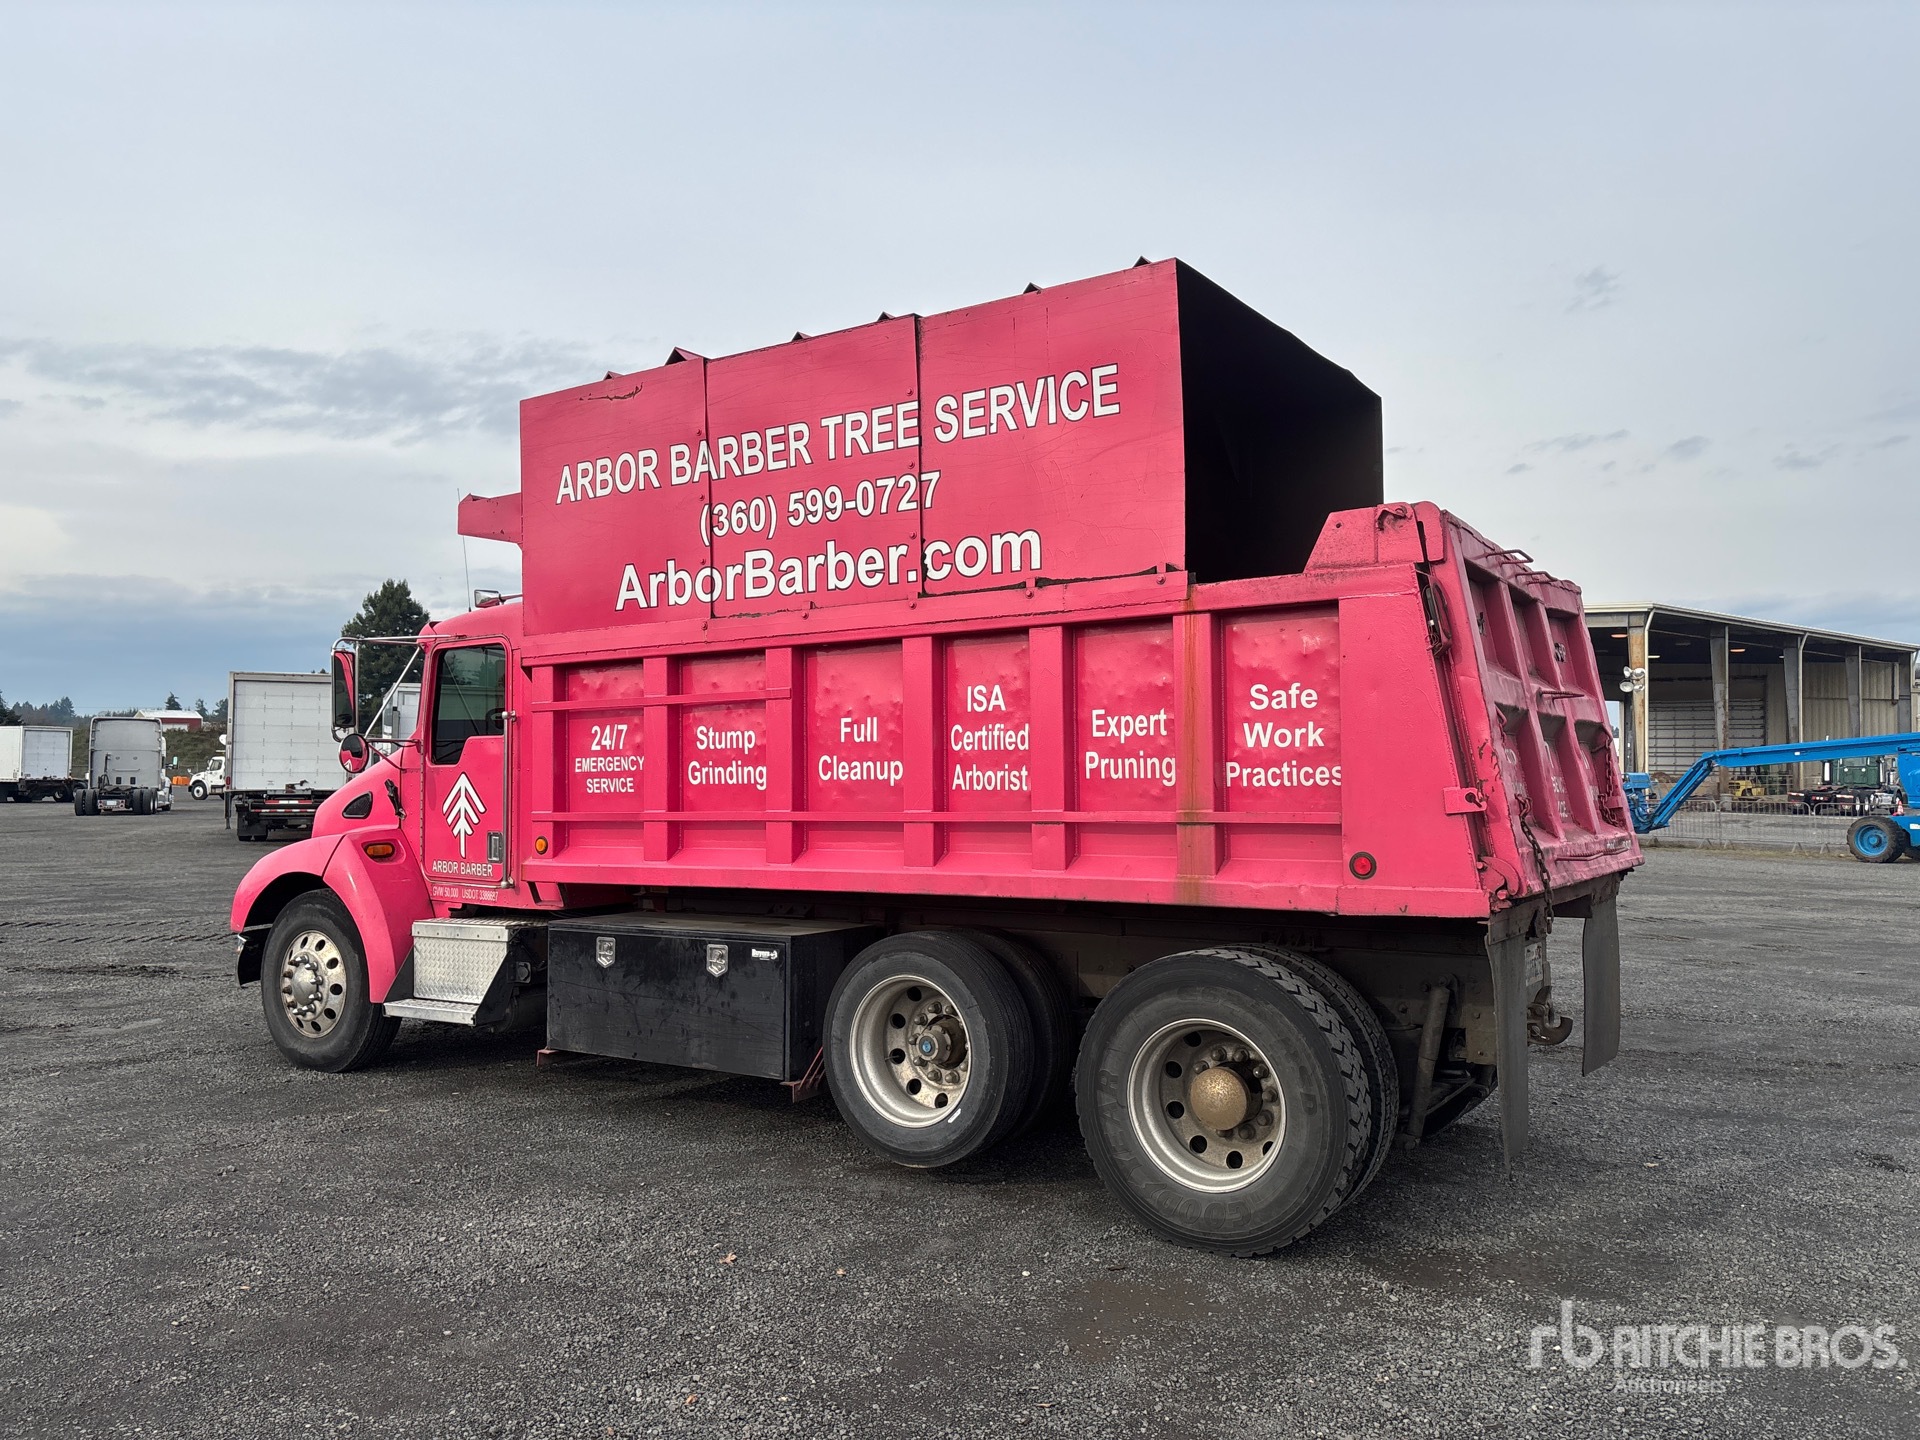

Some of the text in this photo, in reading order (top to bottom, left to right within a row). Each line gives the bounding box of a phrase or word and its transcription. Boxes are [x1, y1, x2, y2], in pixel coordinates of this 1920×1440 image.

[556, 363, 1121, 505] ARBOR BARBER TREE SERVICE
[699, 471, 942, 546] (360) 599-0727
[614, 529, 1042, 612] ArborBarber.com
[966, 684, 1006, 713] ISA
[1248, 682, 1319, 711] Safe
[590, 724, 629, 751] 24/7
[839, 716, 878, 743] Full
[950, 724, 1030, 752] Certified
[1091, 707, 1168, 743] Expert
[1242, 722, 1325, 749] Work
[696, 725, 756, 755] Stump
[574, 755, 645, 773] EMERGENCY
[687, 760, 767, 790] Grinding
[818, 754, 904, 786] Cleanup
[951, 764, 1029, 792] Arborist
[1084, 751, 1177, 788] Pruning
[1226, 761, 1342, 788] Practices
[586, 777, 635, 794] SERVICE
[432, 860, 493, 877] ARBOR BARBER
[461, 888, 479, 900] USDOT
